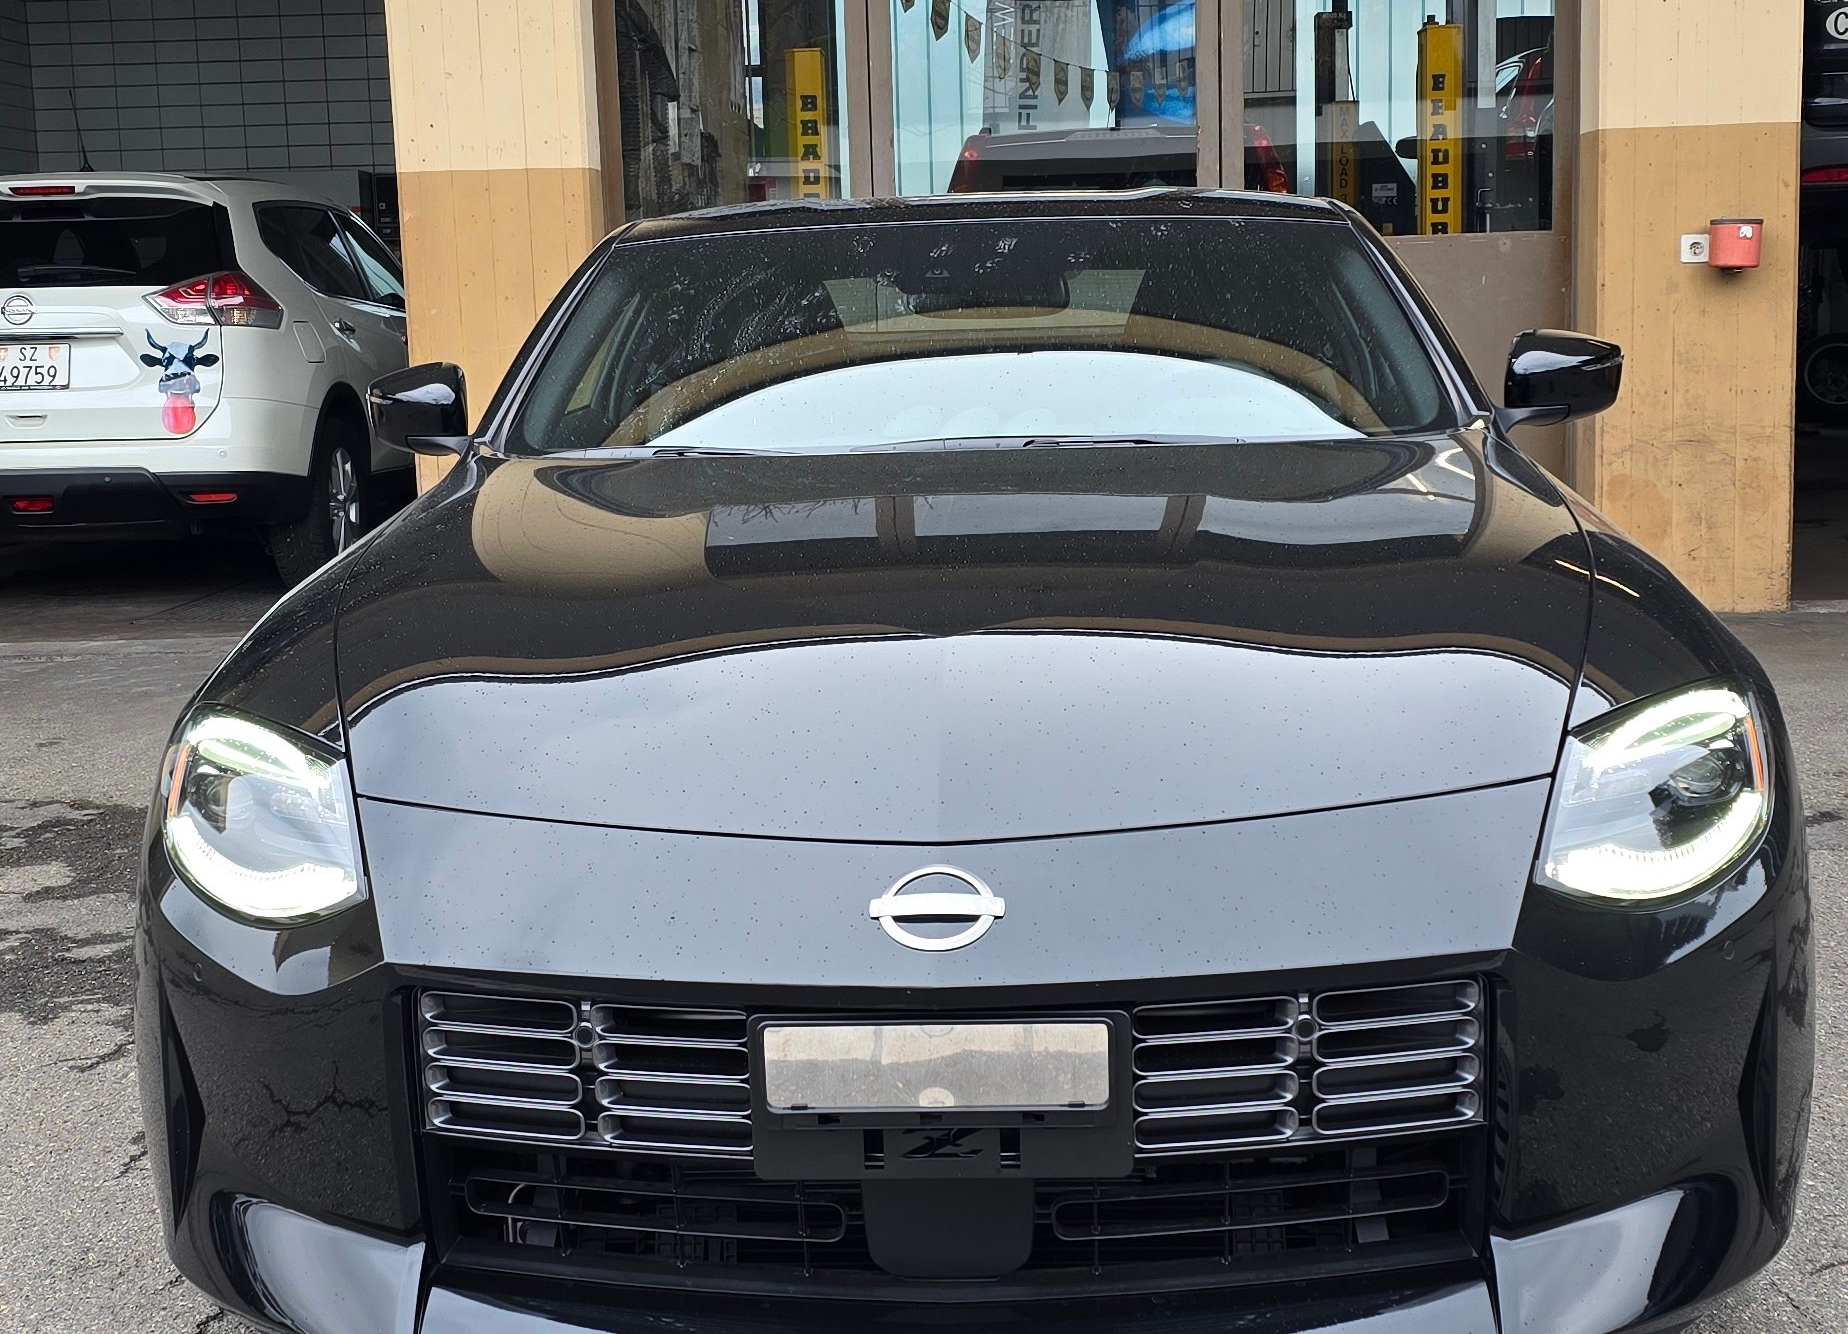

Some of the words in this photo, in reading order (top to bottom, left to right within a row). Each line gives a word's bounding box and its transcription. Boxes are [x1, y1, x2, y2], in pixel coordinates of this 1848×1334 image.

[1339, 106, 1350, 140] MAX
[799, 94, 822, 198] BRAD
[1339, 144, 1349, 189] LOAD
[18, 346, 38, 362] SZ
[0, 365, 57, 386] 49759
